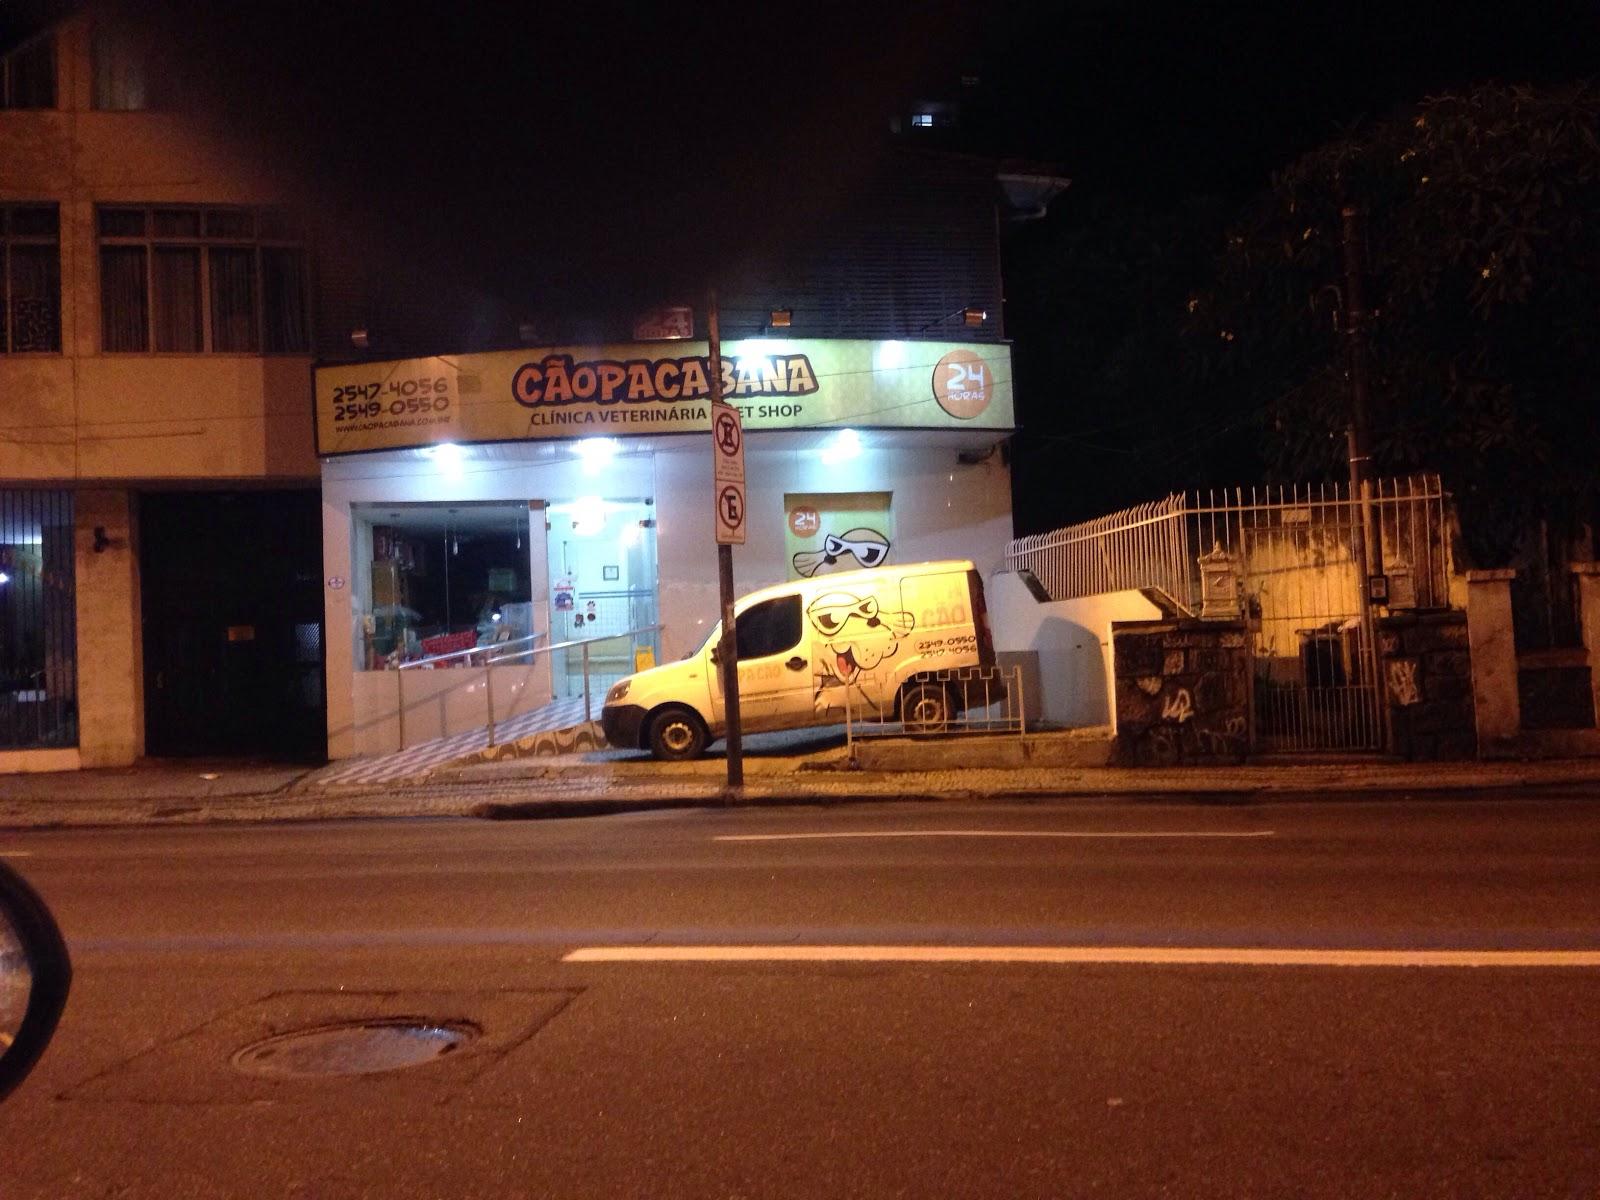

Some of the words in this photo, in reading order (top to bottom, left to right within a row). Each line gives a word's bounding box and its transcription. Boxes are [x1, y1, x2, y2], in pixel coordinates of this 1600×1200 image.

[513, 355, 819, 407] CÃOPACABANA
[946, 362, 985, 391] 24
[333, 377, 448, 403] 2547-4056
[947, 391, 985, 401] HORAS
[334, 396, 450, 421] 2549-0550
[531, 408, 594, 426] CLÍNICA
[599, 404, 707, 424] VETERINÁRIA
[758, 404, 803, 419] SHOP
[794, 511, 816, 526] 24
